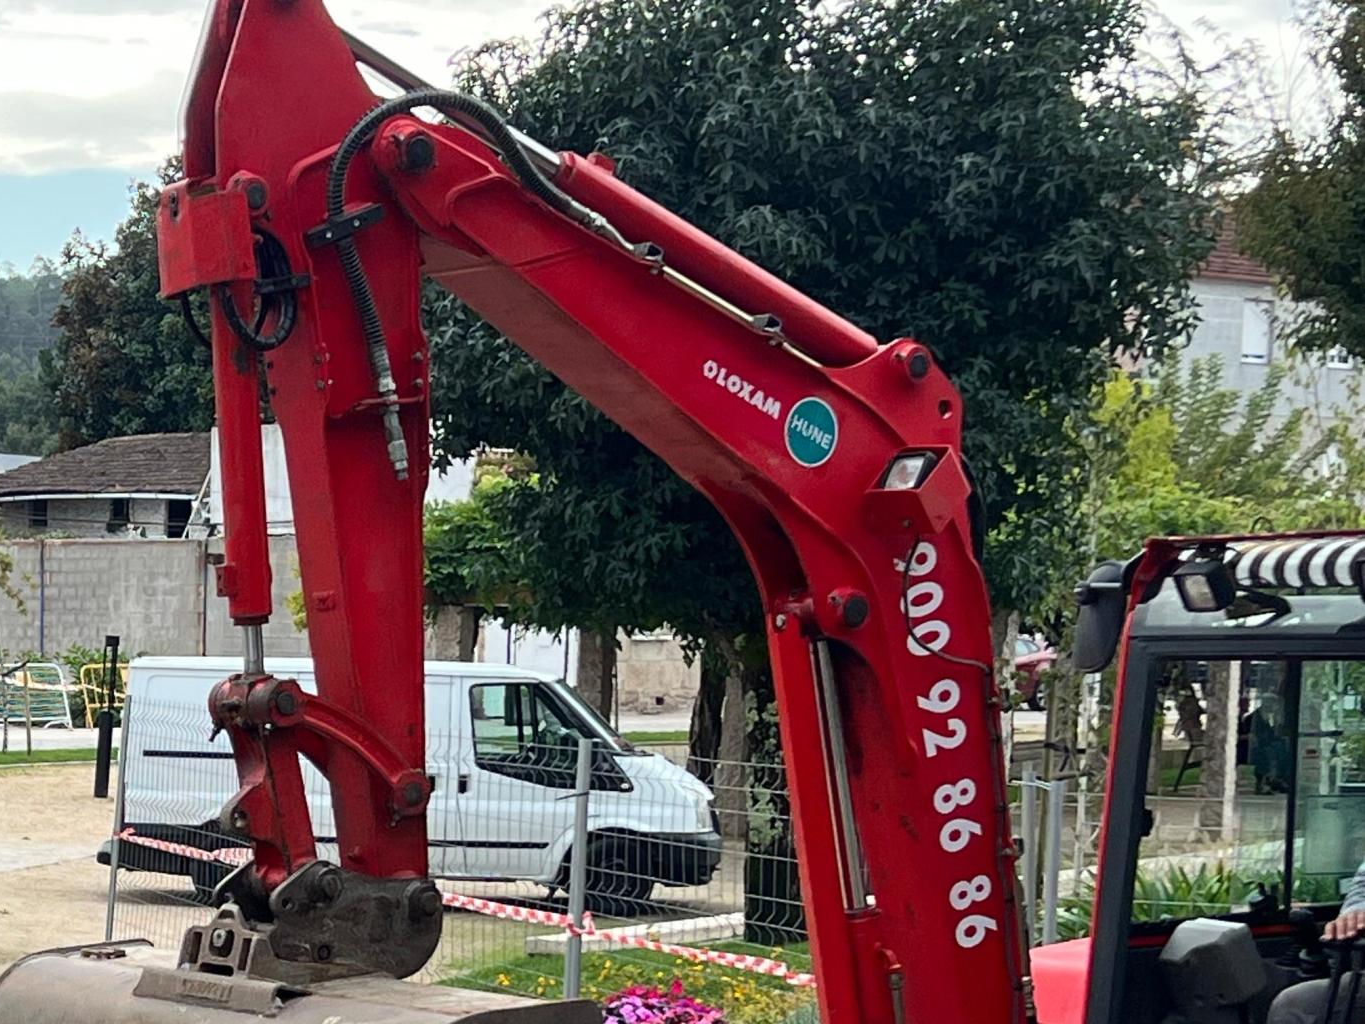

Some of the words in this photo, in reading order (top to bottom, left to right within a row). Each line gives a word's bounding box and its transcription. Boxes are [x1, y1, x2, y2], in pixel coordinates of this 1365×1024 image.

[790, 414, 833, 450] HUNE
[893, 541, 951, 657] 900
[916, 678, 968, 758] 92
[933, 778, 983, 853] 86
[949, 874, 999, 949] 86
